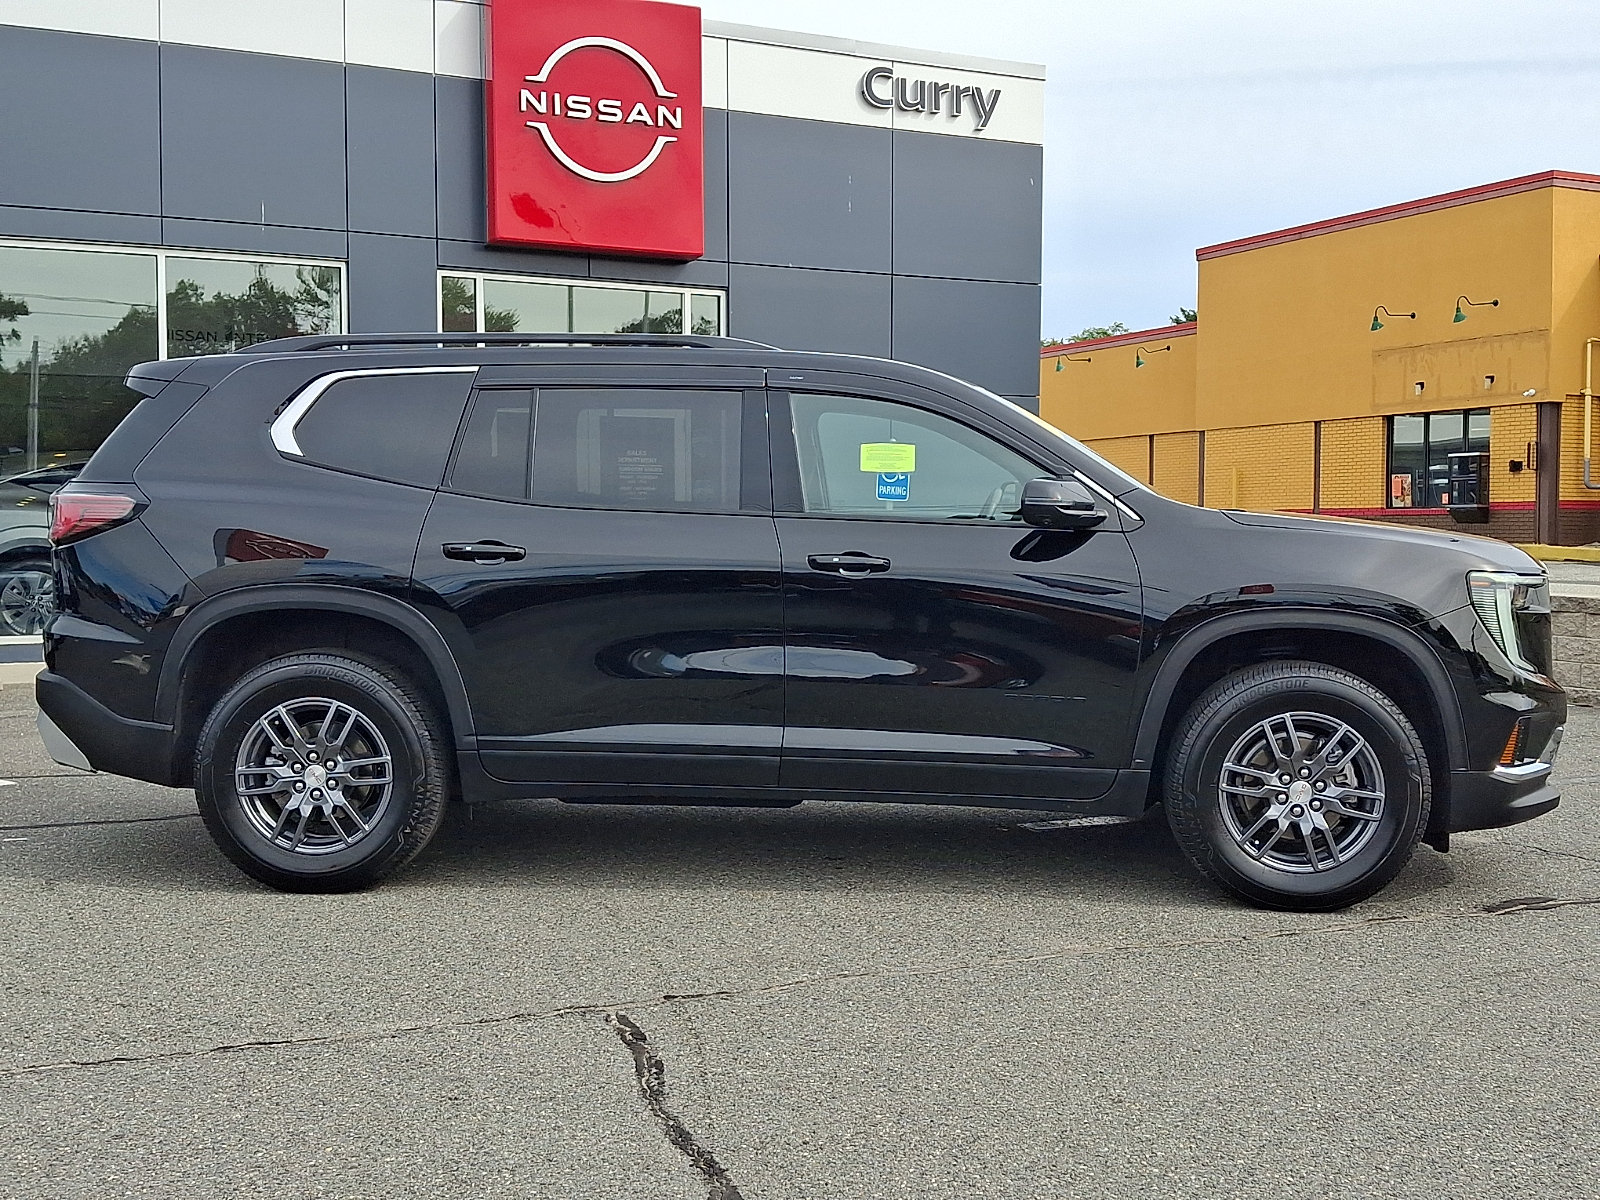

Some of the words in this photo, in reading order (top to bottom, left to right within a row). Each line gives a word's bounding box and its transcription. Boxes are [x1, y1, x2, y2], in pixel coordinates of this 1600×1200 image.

[519, 88, 682, 129] NISSAN
[862, 66, 1001, 131] Curry
[167, 329, 217, 342] ISSAN
[879, 485, 907, 496] PARKING
[304, 664, 383, 697] BRIDGESTONE
[404, 785, 425, 833] ALENZA
